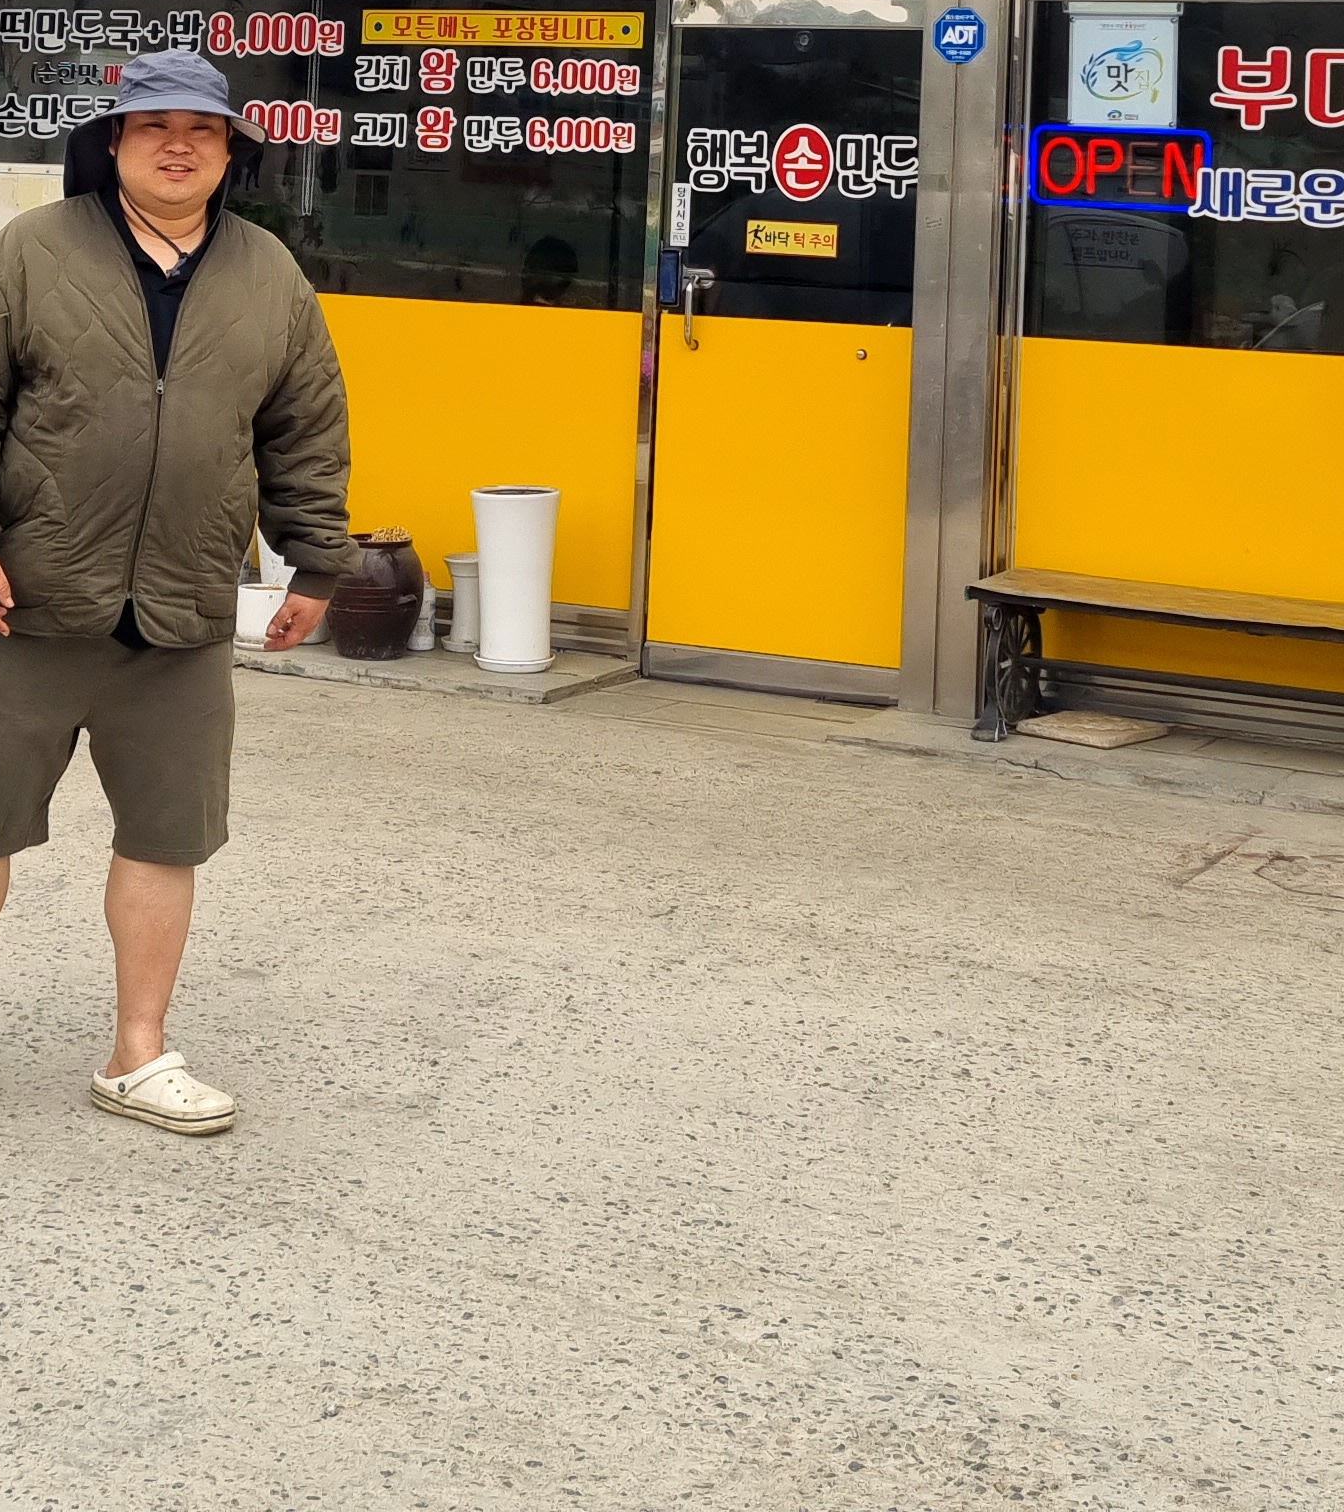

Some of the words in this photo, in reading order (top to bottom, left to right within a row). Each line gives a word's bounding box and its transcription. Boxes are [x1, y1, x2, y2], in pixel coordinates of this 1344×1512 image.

[207, 11, 345, 58] 8,000원
[392, 15, 481, 39] 모든메뉴
[492, 16, 615, 42] 포장됩니다.
[941, 24, 978, 45] ADT
[354, 55, 410, 93] 김치
[418, 48, 459, 95] 왕
[466, 56, 525, 94] 만두
[530, 58, 640, 97] 6,000원
[351, 112, 407, 149] 고기
[415, 106, 456, 153] 왕
[463, 115, 524, 153] 만두
[526, 116, 637, 156] 6,000원
[1039, 135, 1205, 199] OPEN
[675, 187, 687, 230] 당기시오
[765, 230, 790, 247] 바닥
[793, 232, 805, 248] 턱
[809, 233, 835, 250] 주의
